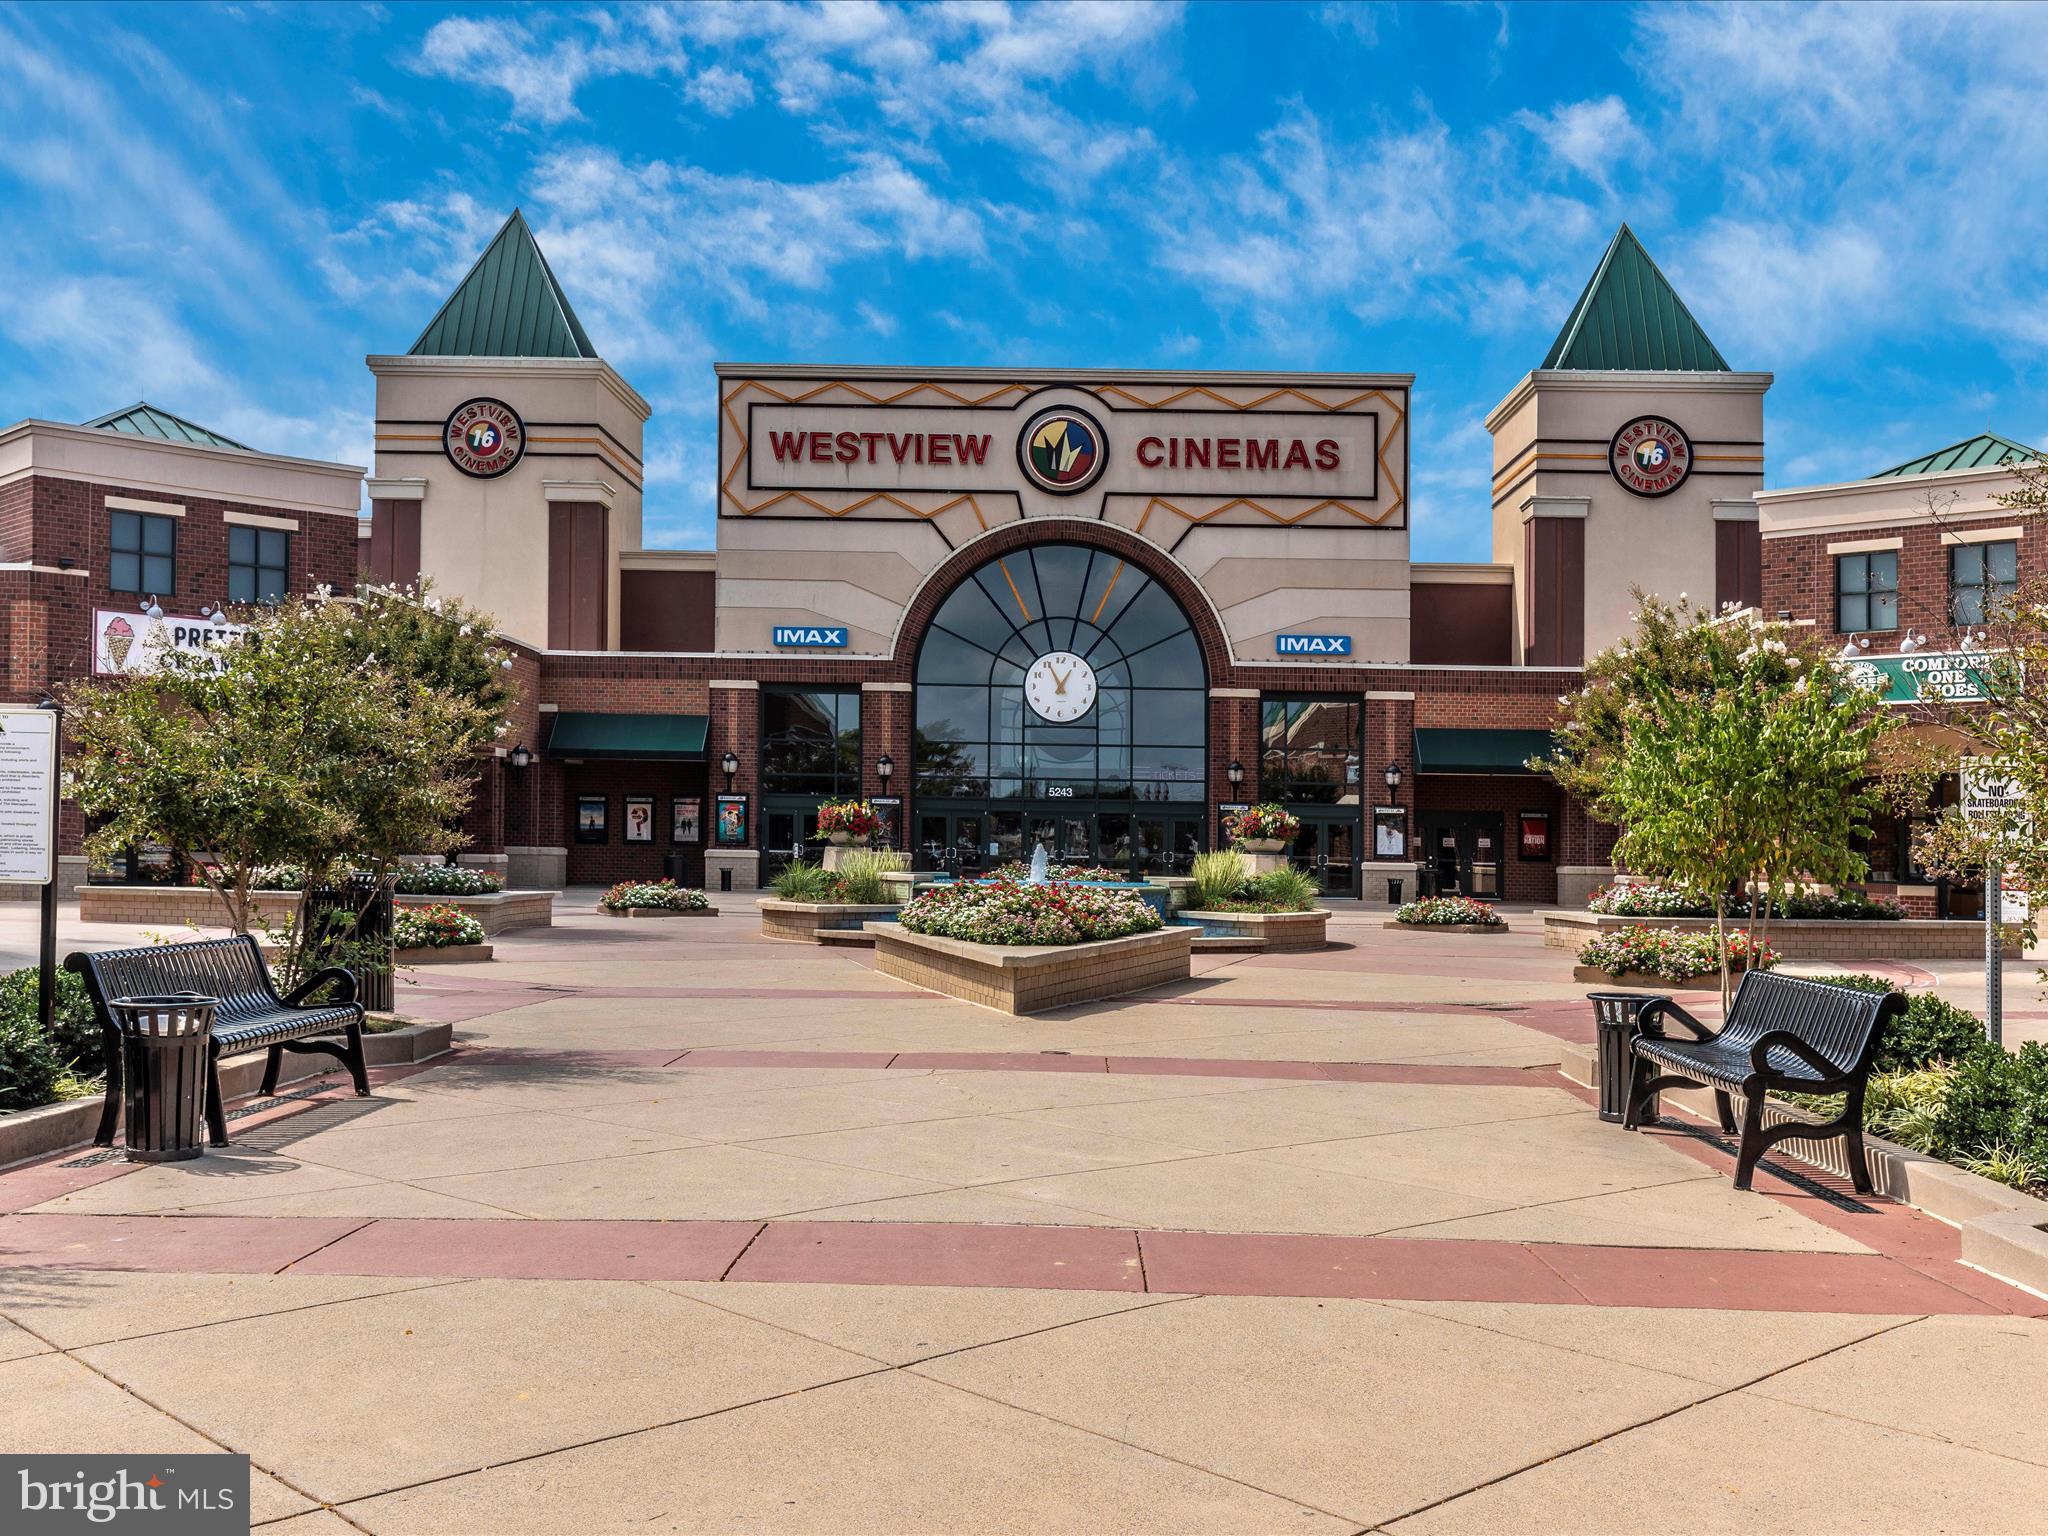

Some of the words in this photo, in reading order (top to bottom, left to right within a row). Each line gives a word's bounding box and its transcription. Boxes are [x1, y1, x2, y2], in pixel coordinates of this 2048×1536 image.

[451, 405, 518, 439] WESTVIEW
[473, 429, 495, 448] 16
[1617, 423, 1686, 458] WESTVIEW
[454, 446, 515, 472] CINEMAS
[768, 431, 992, 465] WESTVIEW
[1136, 436, 1340, 471] CINEMAS
[1642, 447, 1664, 465] 16
[1621, 464, 1683, 491] CINEMAS
[776, 629, 841, 643] IMAX
[1280, 637, 1345, 652] IMAX
[1928, 670, 1966, 684] ONE
[1048, 787, 1073, 797] 5243
[1988, 785, 2004, 797] NO
